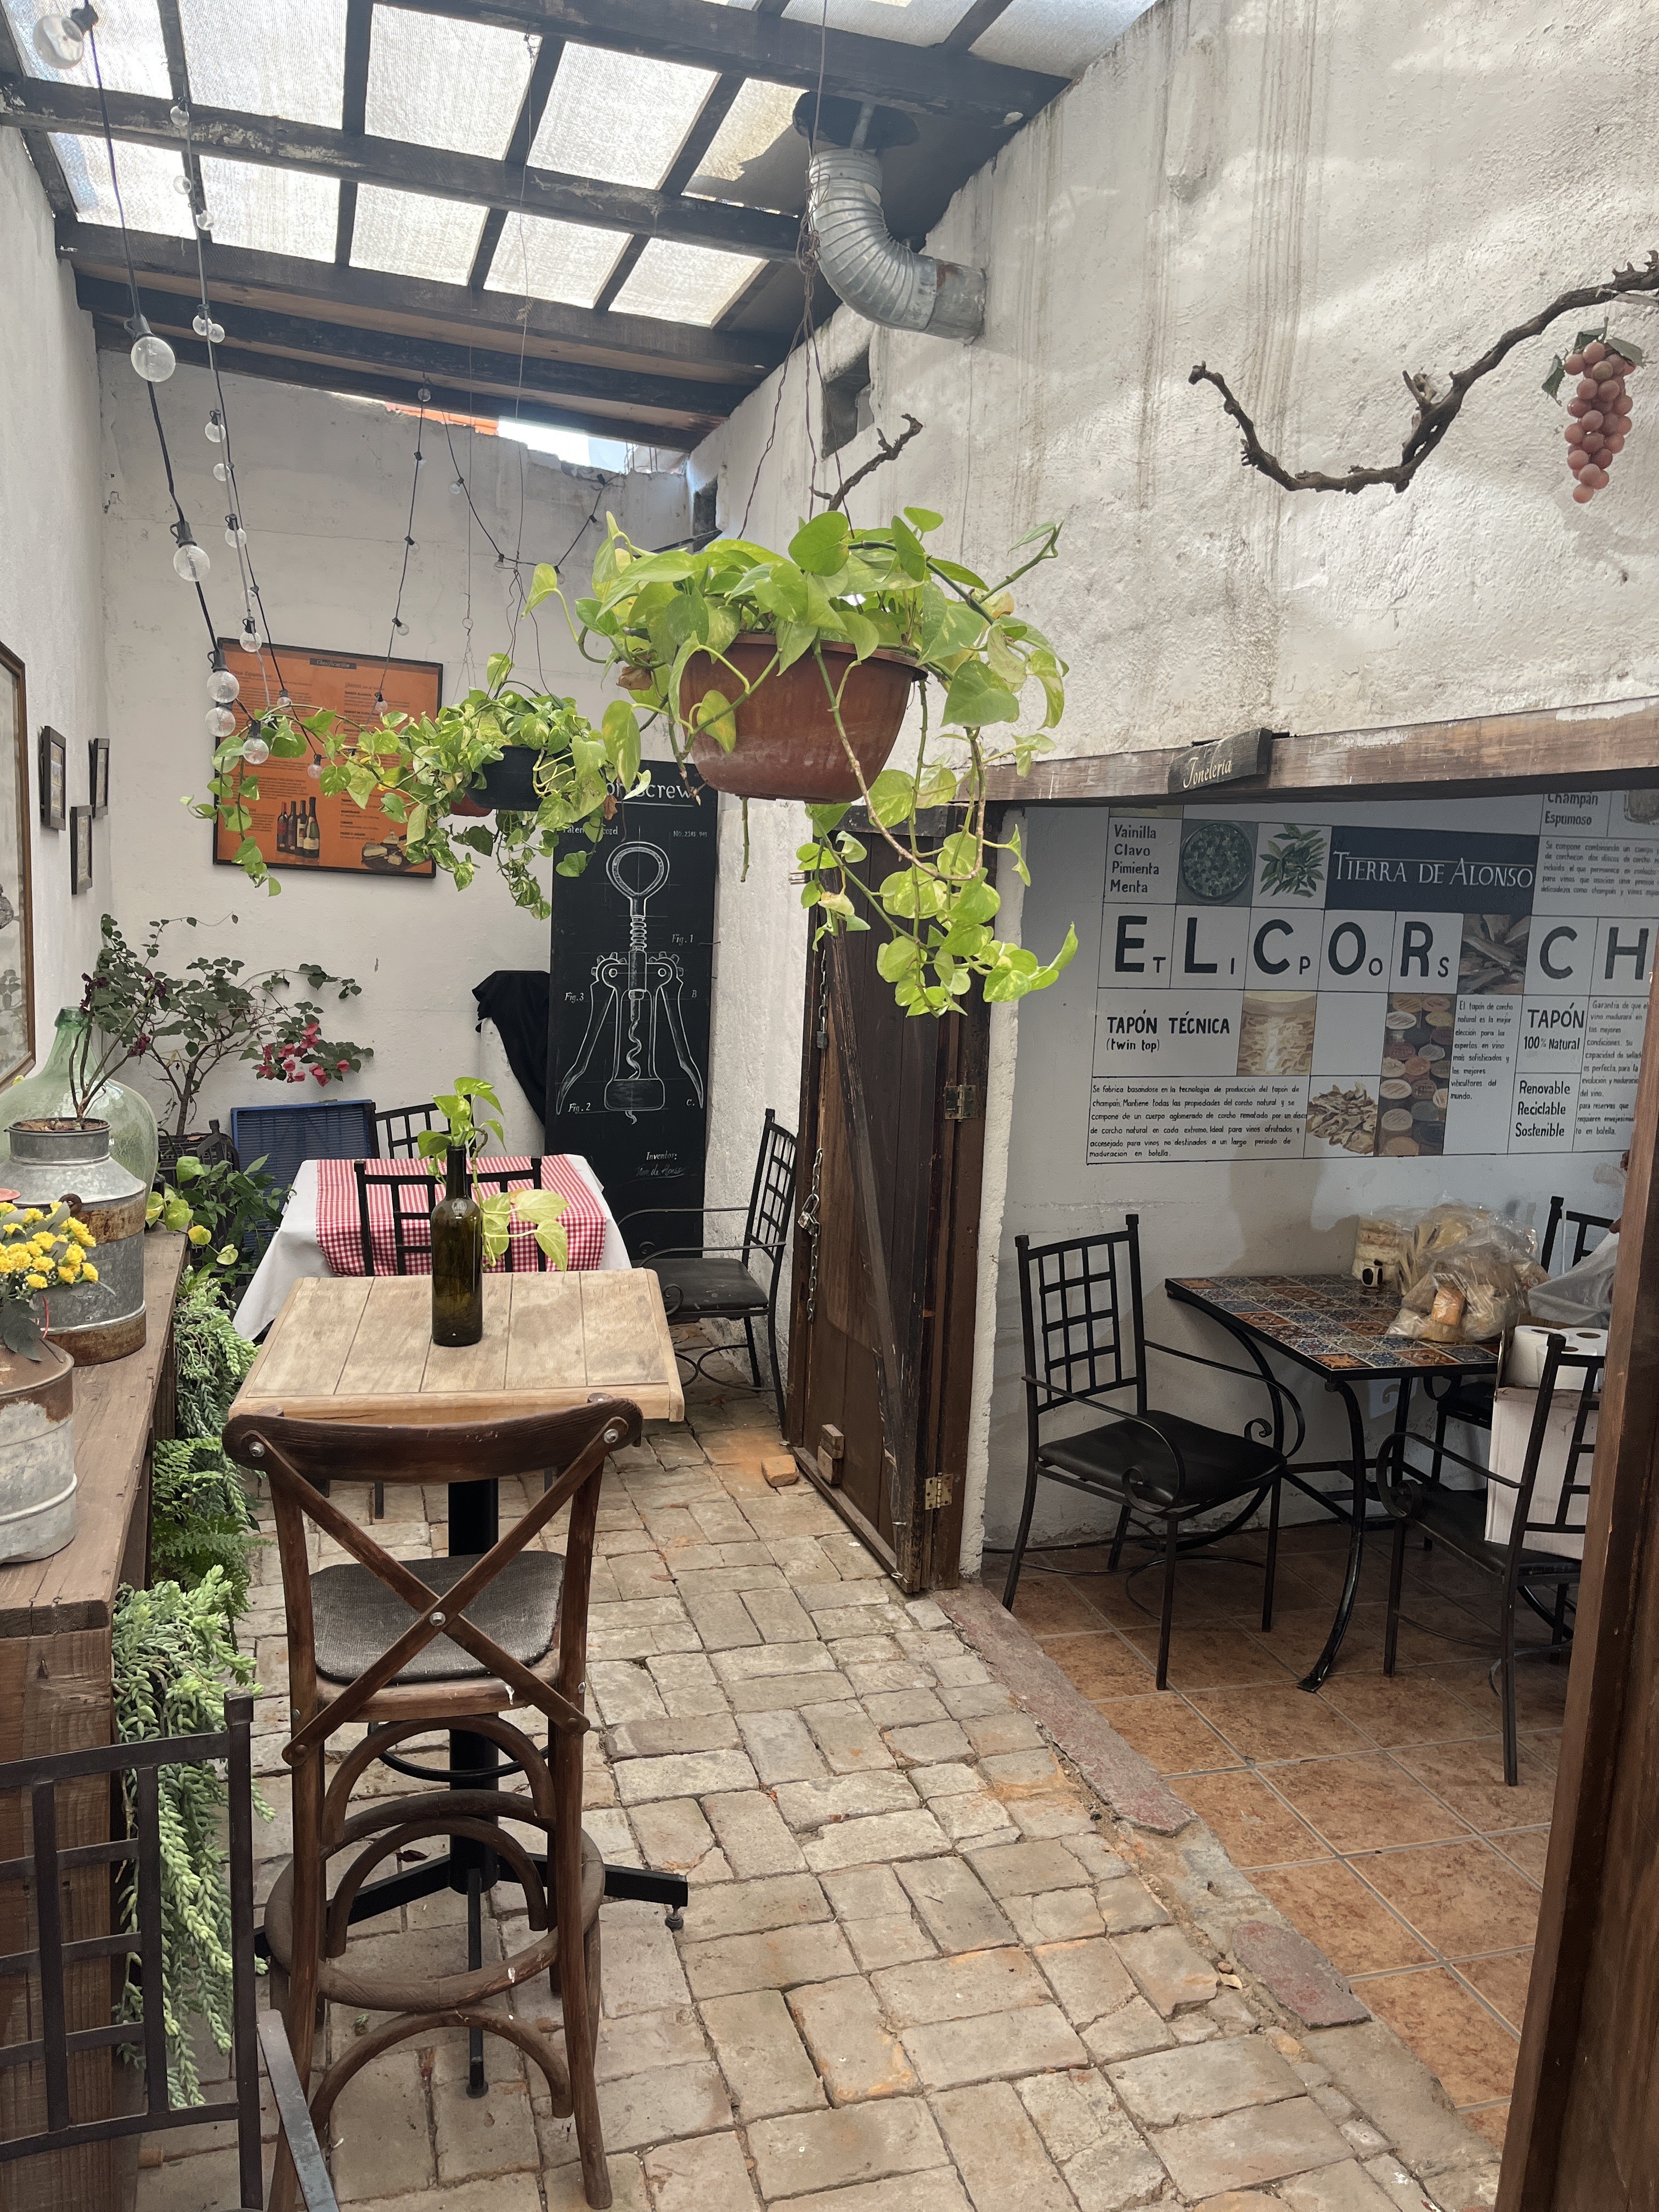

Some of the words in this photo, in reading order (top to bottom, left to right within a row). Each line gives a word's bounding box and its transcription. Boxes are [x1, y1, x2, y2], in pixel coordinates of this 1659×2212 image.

[1544, 810, 1592, 827] Espumoso
[1114, 823, 1156, 839] Vainilla
[1114, 844, 1150, 856] Clavo
[1111, 861, 1160, 875] Pimienta
[1333, 850, 1407, 883] TIERRA
[1419, 863, 1444, 884] DE
[1449, 857, 1533, 888] ALONSO
[1110, 879, 1148, 893] Menta
[1496, 1002, 1513, 1011] corcho
[1107, 1009, 1157, 1034] TAPÓN
[1169, 1011, 1230, 1034] TÉCNICA
[1496, 1015, 1511, 1025] mejor
[1527, 1002, 1584, 1029] TAPÓN
[1106, 1037, 1136, 1051] (twin
[1142, 1038, 1160, 1053] top)
[1454, 1041, 1477, 1050] expertos
[1492, 1040, 1505, 1049] vino
[1548, 1037, 1581, 1050] Natural
[1463, 1066, 1486, 1076] mejores
[1633, 1064, 1638, 1072] la
[1272, 1085, 1288, 1095] tapón
[1519, 1080, 1571, 1094] Renovable
[1123, 1099, 1149, 1107] Mantiene
[1153, 1098, 1169, 1107] todas
[1184, 1099, 1220, 1108] propiedades
[1517, 1101, 1566, 1115] Reciclable
[1091, 1114, 1119, 1122] compone
[1169, 1112, 1203, 1121] aglomerado
[1240, 1110, 1268, 1119] rematado
[1126, 1125, 1148, 1133] natural
[1515, 1122, 1565, 1137] Sostenible
[1090, 1139, 1123, 1148] aconsejado
[1231, 1137, 1247, 1147] largo
